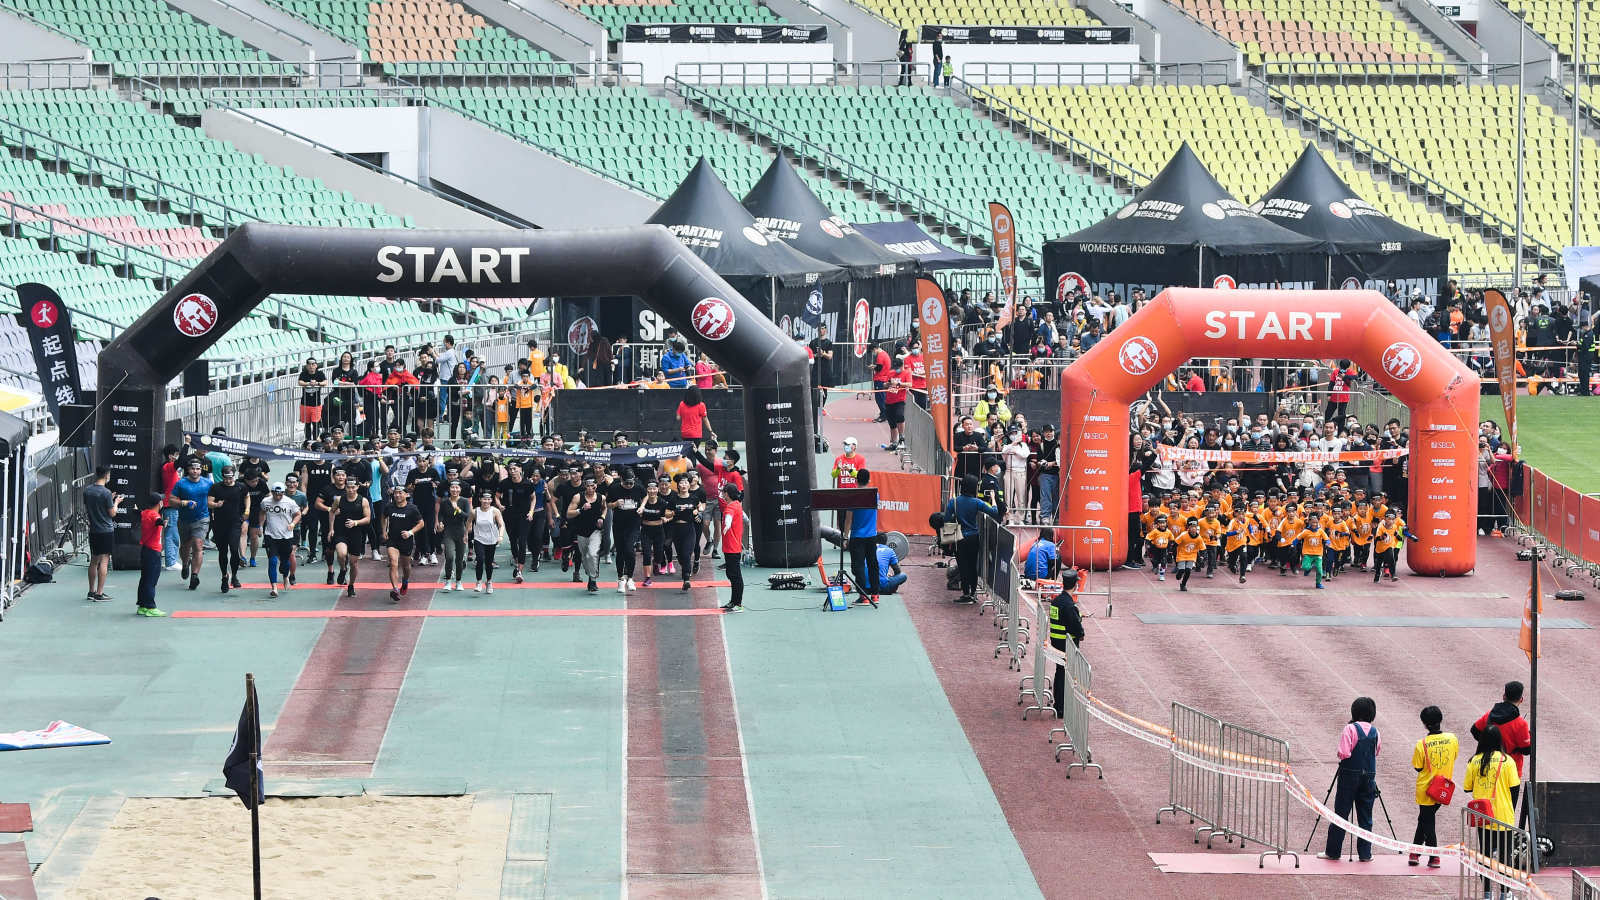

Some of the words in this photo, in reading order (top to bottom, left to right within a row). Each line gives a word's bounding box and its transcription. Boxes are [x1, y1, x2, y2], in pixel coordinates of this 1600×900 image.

[1140, 200, 1185, 214] SPARTAN
[1265, 198, 1312, 213] SPARTAN
[1079, 243, 1118, 253] WOMENS
[1119, 244, 1165, 255] CHANGING
[376, 245, 530, 283] START
[1204, 310, 1342, 341] START
[41, 334, 77, 406] 起点线
[926, 333, 948, 405] 起点线
[119, 419, 137, 427] SECA
[775, 416, 792, 424] SECA
[1091, 432, 1108, 440] SECA
[211, 437, 249, 450] SPARTAN
[1438, 441, 1456, 449] SECA
[647, 444, 683, 458] SPARTAN
[877, 499, 910, 512] SPARTAN
